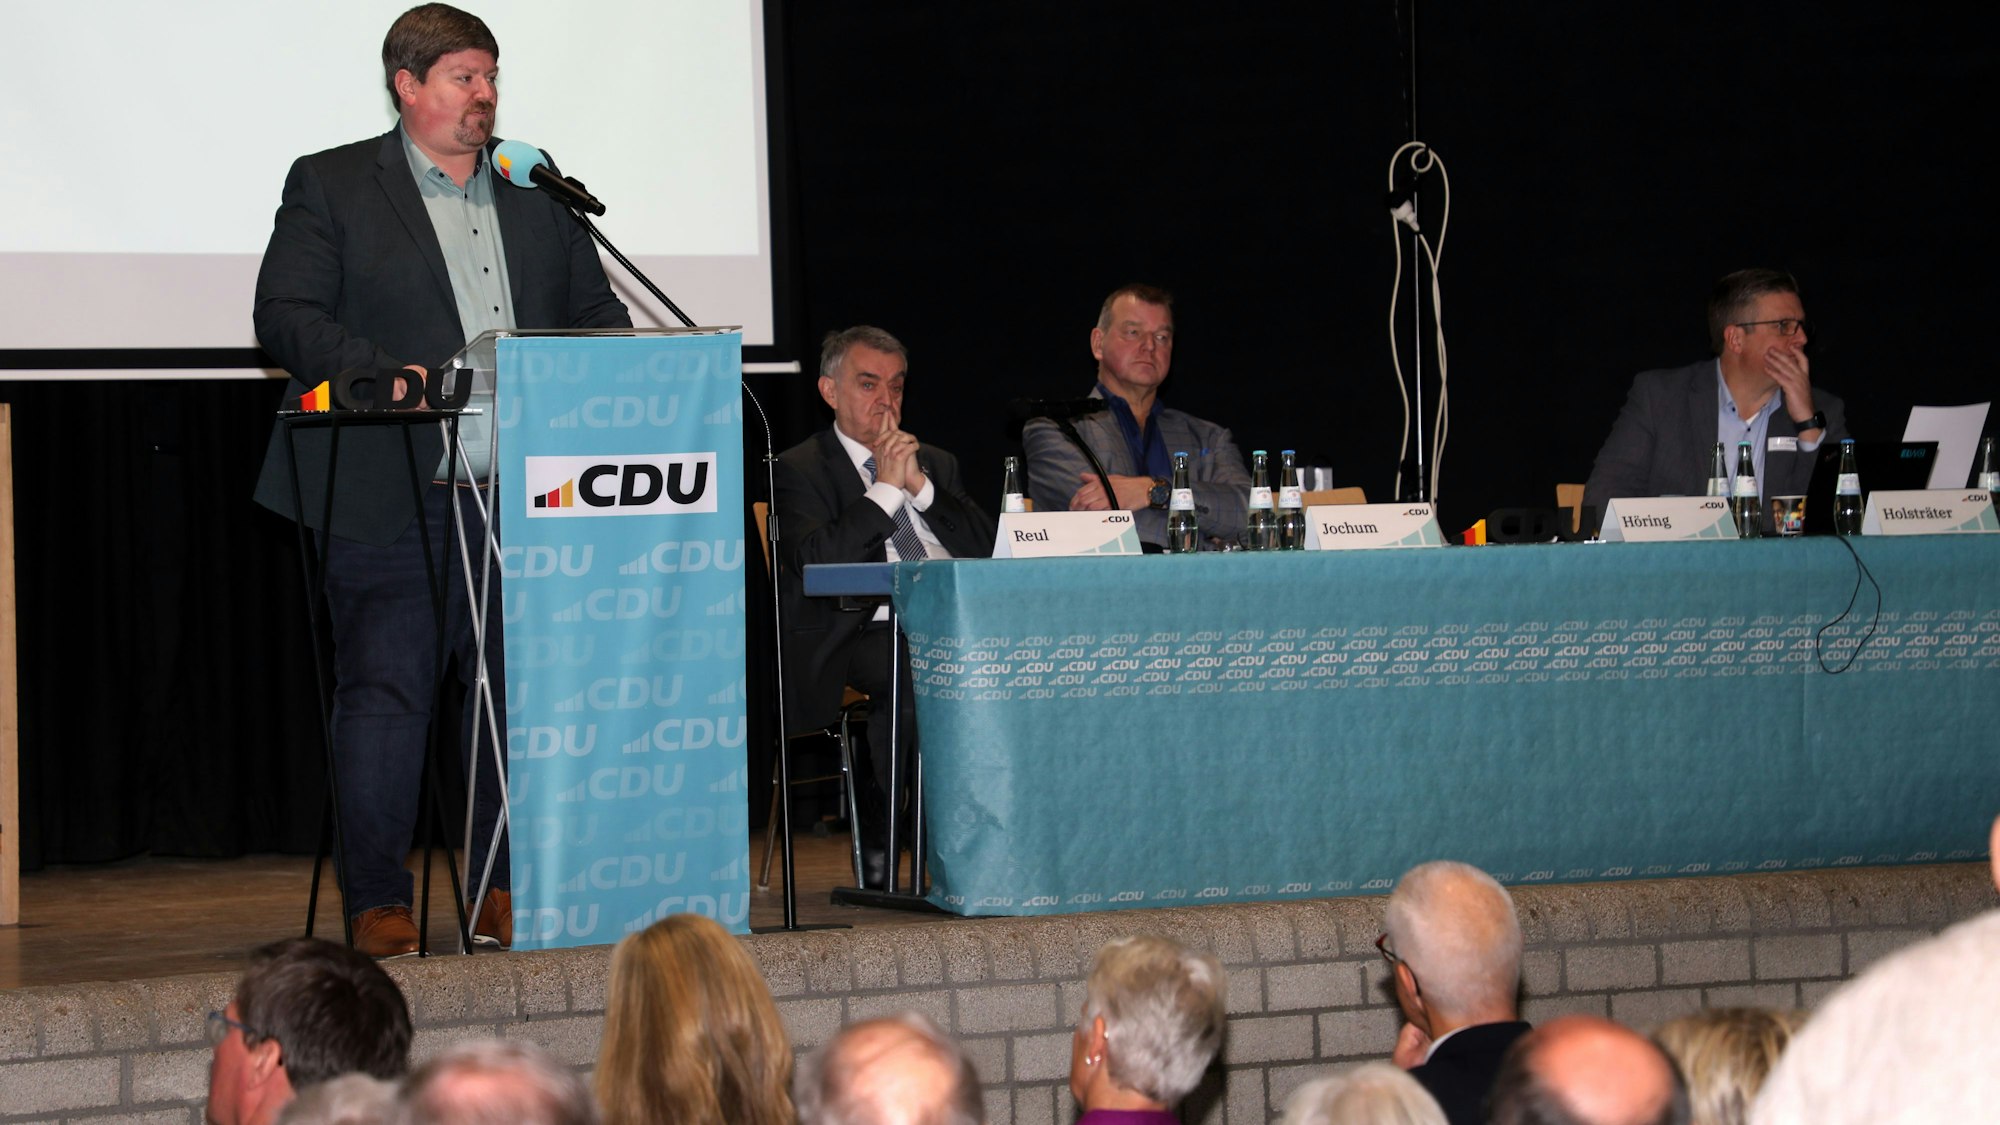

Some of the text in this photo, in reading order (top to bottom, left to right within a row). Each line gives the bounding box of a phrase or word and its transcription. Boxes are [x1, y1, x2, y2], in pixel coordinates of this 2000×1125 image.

[648, 345, 740, 383] CDU
[335, 368, 474, 410] CDU
[582, 394, 680, 428] CDU
[578, 462, 708, 507] CDU
[1968, 494, 1988, 502] CDU
[1322, 522, 1379, 535] Jochum
[1408, 508, 1429, 516] CDU
[1622, 514, 1672, 530] Höring
[1883, 506, 1953, 520] Holsträter
[1013, 529, 1049, 542] Reul
[501, 540, 743, 578] CDU CDU
[585, 586, 682, 621] CDU
[653, 628, 744, 661] CDU
[930, 649, 952, 661] CDU
[970, 651, 998, 662] CDU
[1014, 650, 1041, 660] CDU
[1057, 649, 1084, 659] CDU
[1099, 648, 1126, 658] CDU
[1141, 646, 1169, 656] CDU
[1183, 644, 1211, 655] CDU
[1226, 643, 1252, 653] CDU
[1267, 642, 1294, 652] CDU
[1309, 641, 1335, 651] CDU
[1351, 640, 1377, 650] CDU
[1391, 639, 1417, 648] CDU
[1431, 637, 1457, 647] CDU
[1472, 636, 1497, 646] CDU
[1513, 635, 1537, 645] CDU
[1553, 634, 1577, 643] CDU
[1592, 633, 1616, 642] CDU
[1631, 632, 1656, 641] CDU
[1670, 630, 1695, 640] CDU
[1710, 629, 1734, 639] CDU
[1749, 628, 1773, 638] CDU
[1787, 627, 1811, 637] CDU
[1902, 624, 1927, 634] CDU
[1941, 623, 1965, 633] CDU
[939, 637, 964, 648] CDU
[980, 637, 1010, 648] CDU
[1026, 636, 1053, 647] CDU
[1069, 635, 1095, 646] CDU
[1111, 634, 1138, 644] CDU
[1153, 633, 1180, 643] CDU
[1197, 632, 1222, 641] CDU
[1237, 630, 1264, 640] CDU
[1279, 629, 1306, 639] CDU
[1321, 628, 1347, 638] CDU
[1362, 627, 1387, 637] CDU
[1402, 626, 1428, 636] CDU
[1443, 625, 1468, 634] CDU
[1484, 623, 1508, 633] CDU
[1523, 622, 1548, 632] CDU
[912, 635, 1977, 674] CDU CDU CDU CDU CDU CDU CDU CDU CDU CDU CDU CDU CDU CDU CDU CDU CDU CDU CDU CDU CDU CDU CDU CDU CDU CDU CDU
[930, 674, 952, 687] CDU
[970, 677, 999, 688] CDU
[1014, 676, 1042, 686] CDU
[1057, 674, 1084, 685] CDU
[1100, 673, 1127, 684] CDU
[1142, 672, 1170, 682] CDU
[1184, 670, 1212, 680] CDU
[1226, 669, 1253, 679] CDU
[1268, 668, 1295, 678] CDU
[1310, 667, 1336, 677] CDU
[1352, 665, 1378, 675] CDU
[1392, 664, 1418, 674] CDU
[1432, 663, 1458, 673] CDU
[1473, 661, 1498, 671] CDU
[1513, 660, 1537, 670] CDU
[1553, 659, 1578, 669] CDU
[1592, 658, 1617, 668] CDU
[1632, 656, 1656, 666] CDU
[1671, 655, 1696, 665] CDU
[1710, 654, 1734, 664] CDU
[1749, 653, 1773, 663] CDU
[1787, 651, 1811, 661] CDU
[1826, 650, 1850, 661] CDU
[1865, 649, 1889, 659] CDU
[1903, 648, 1928, 658] CDU
[1941, 647, 1966, 657] CDU
[587, 674, 684, 711] CDU
[939, 682, 1265, 700] CDU CDU CDU CDU CDU CDU CDU CDU
[507, 716, 746, 760] CDU CDU
[588, 764, 685, 800] CDU
[655, 804, 748, 840] CDU
[590, 852, 686, 890] CDU
[1032, 896, 1059, 906] CDU
[1119, 891, 1144, 901] CDU
[1203, 887, 1228, 897] CDU
[1286, 883, 1311, 893] CDU
[1369, 879, 1392, 889] CDU
[1529, 871, 1554, 880] CDU
[1608, 867, 1632, 876] CDU
[1687, 863, 1710, 872] CDU
[1763, 859, 1787, 869] CDU
[1840, 856, 1862, 864] CDU
[1914, 852, 1937, 861] CDU
[514, 904, 600, 942] CDU
